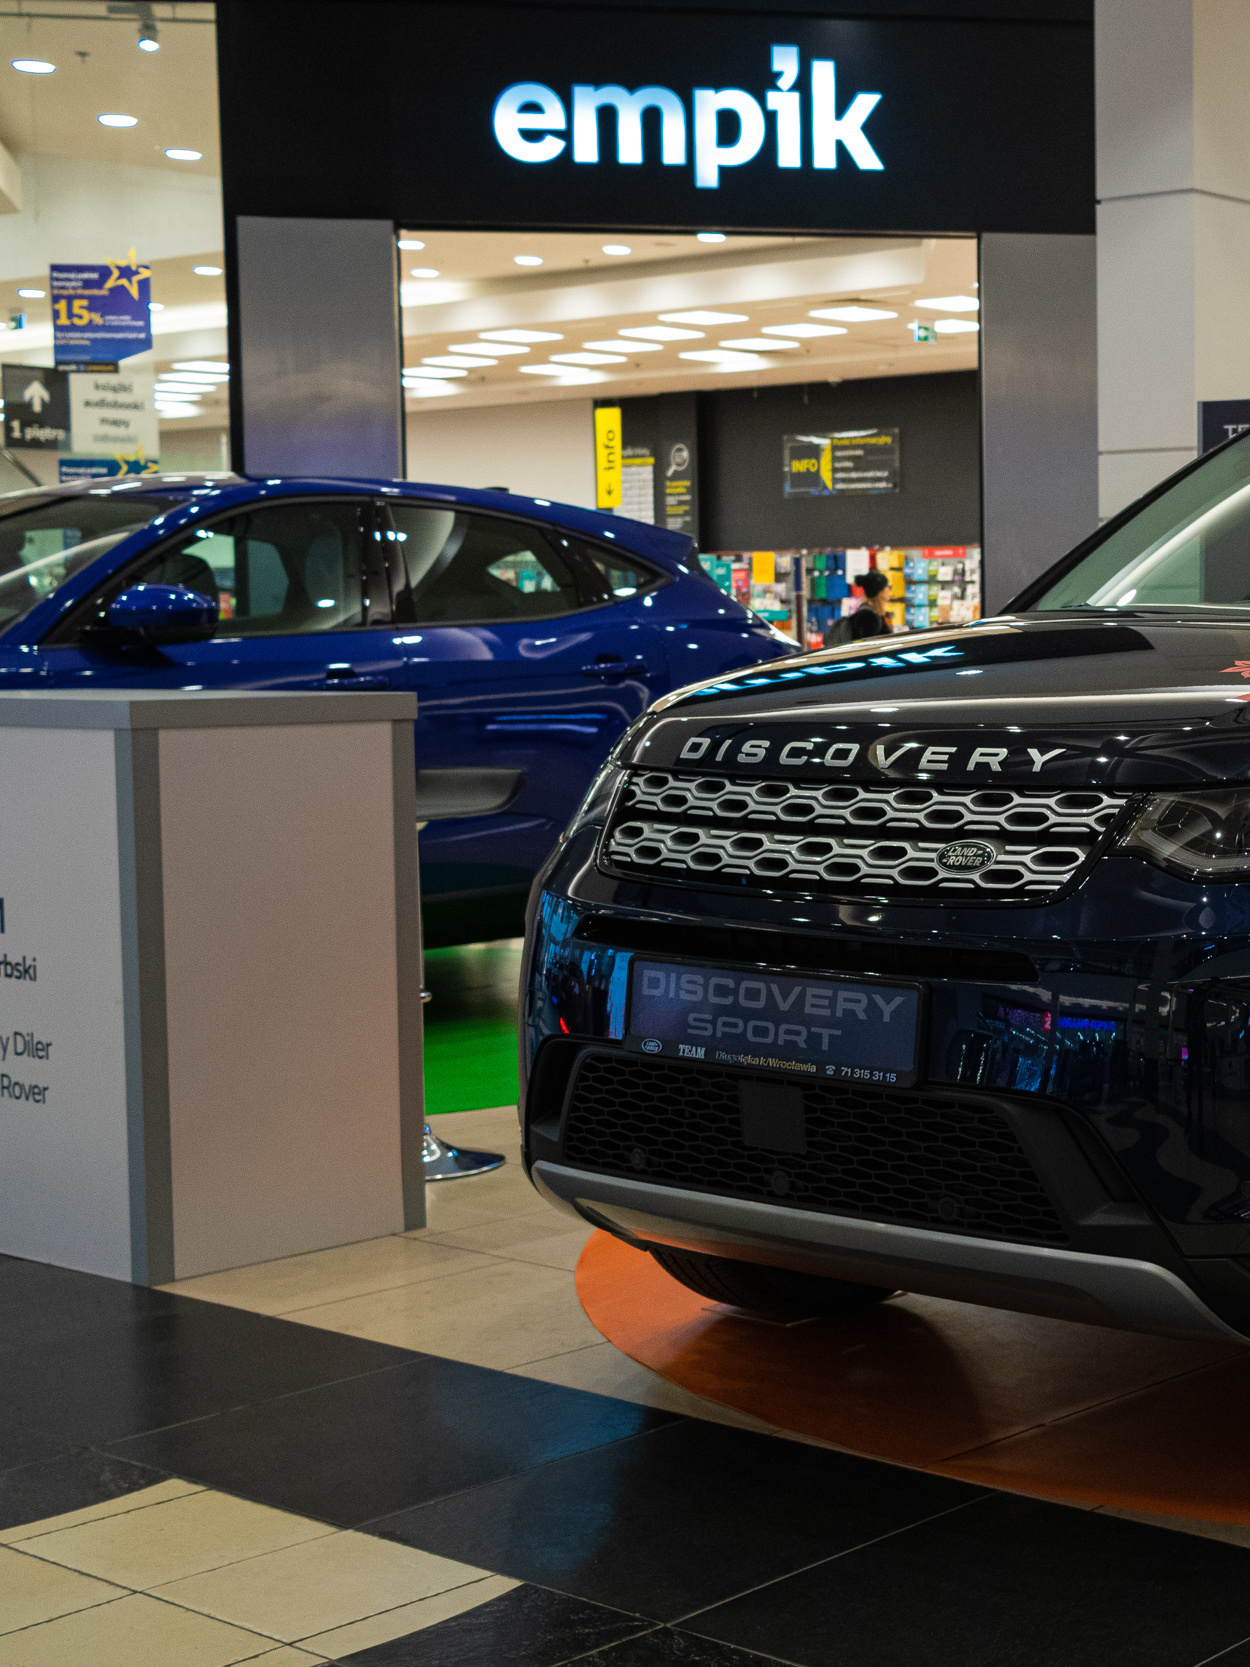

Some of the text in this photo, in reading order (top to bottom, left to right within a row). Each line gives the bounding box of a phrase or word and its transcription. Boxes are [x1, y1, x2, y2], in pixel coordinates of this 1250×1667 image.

[492, 44, 885, 189] empik
[54, 299, 103, 326] 15%
[9, 419, 22, 439] 1
[603, 429, 617, 472] info
[791, 458, 819, 473] INFO
[680, 737, 1067, 773] DISCOVERY
[946, 856, 983, 866] ROVER
[947, 847, 978, 856] LAND
[641, 969, 906, 1023] DISCOVERY
[13, 1031, 53, 1060] Diler
[687, 1012, 842, 1051] SPORT
[678, 1043, 707, 1059] TEAM
[841, 1067, 852, 1077] 71
[853, 1068, 871, 1079] 315
[872, 1070, 884, 1081] 31
[885, 1073, 897, 1083] 15
[0, 1073, 50, 1105] Rover
